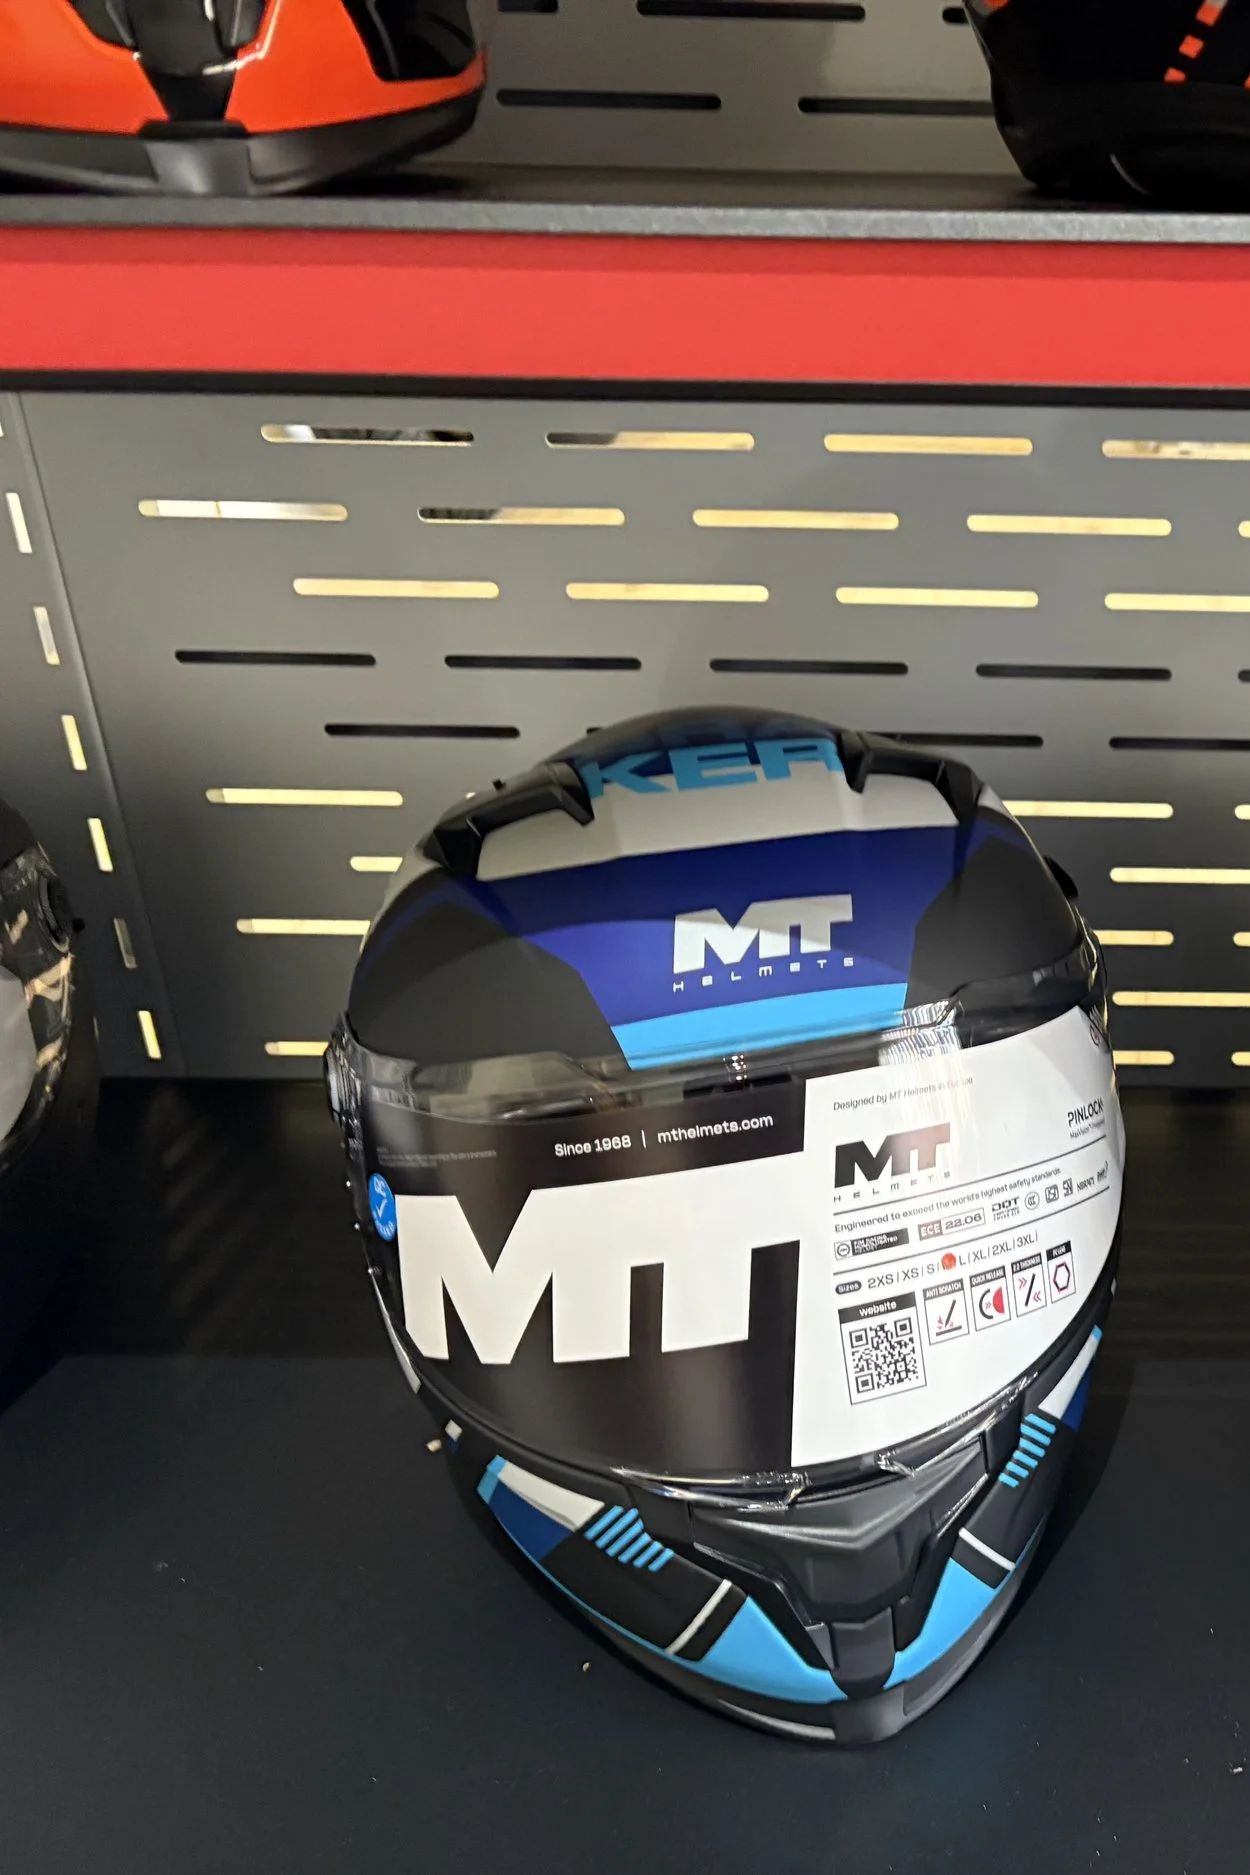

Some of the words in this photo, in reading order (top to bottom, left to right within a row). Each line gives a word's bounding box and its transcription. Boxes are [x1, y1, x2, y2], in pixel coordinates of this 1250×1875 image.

[674, 894, 853, 974] MT
[672, 957, 854, 993] HELMETS
[833, 1095, 874, 1111] Designed
[876, 1093, 887, 1103] by
[889, 1090, 902, 1101] MT
[554, 1143, 592, 1157] Since
[594, 1135, 632, 1152] 1968
[657, 1115, 774, 1144] mthelmets.com
[834, 1122, 950, 1188] MT
[834, 1215, 889, 1233] Engineered
[891, 1212, 901, 1221] to
[902, 1206, 934, 1218] exceed
[936, 1199, 950, 1210] the
[981, 1184, 1008, 1200] highest
[920, 1223, 941, 1237] ECE
[395, 1151, 800, 1365] MT
[868, 1273, 894, 1289] 2XS
[902, 1267, 920, 1281] XS
[973, 1249, 987, 1261] XL
[992, 1243, 1012, 1256] 2XL
